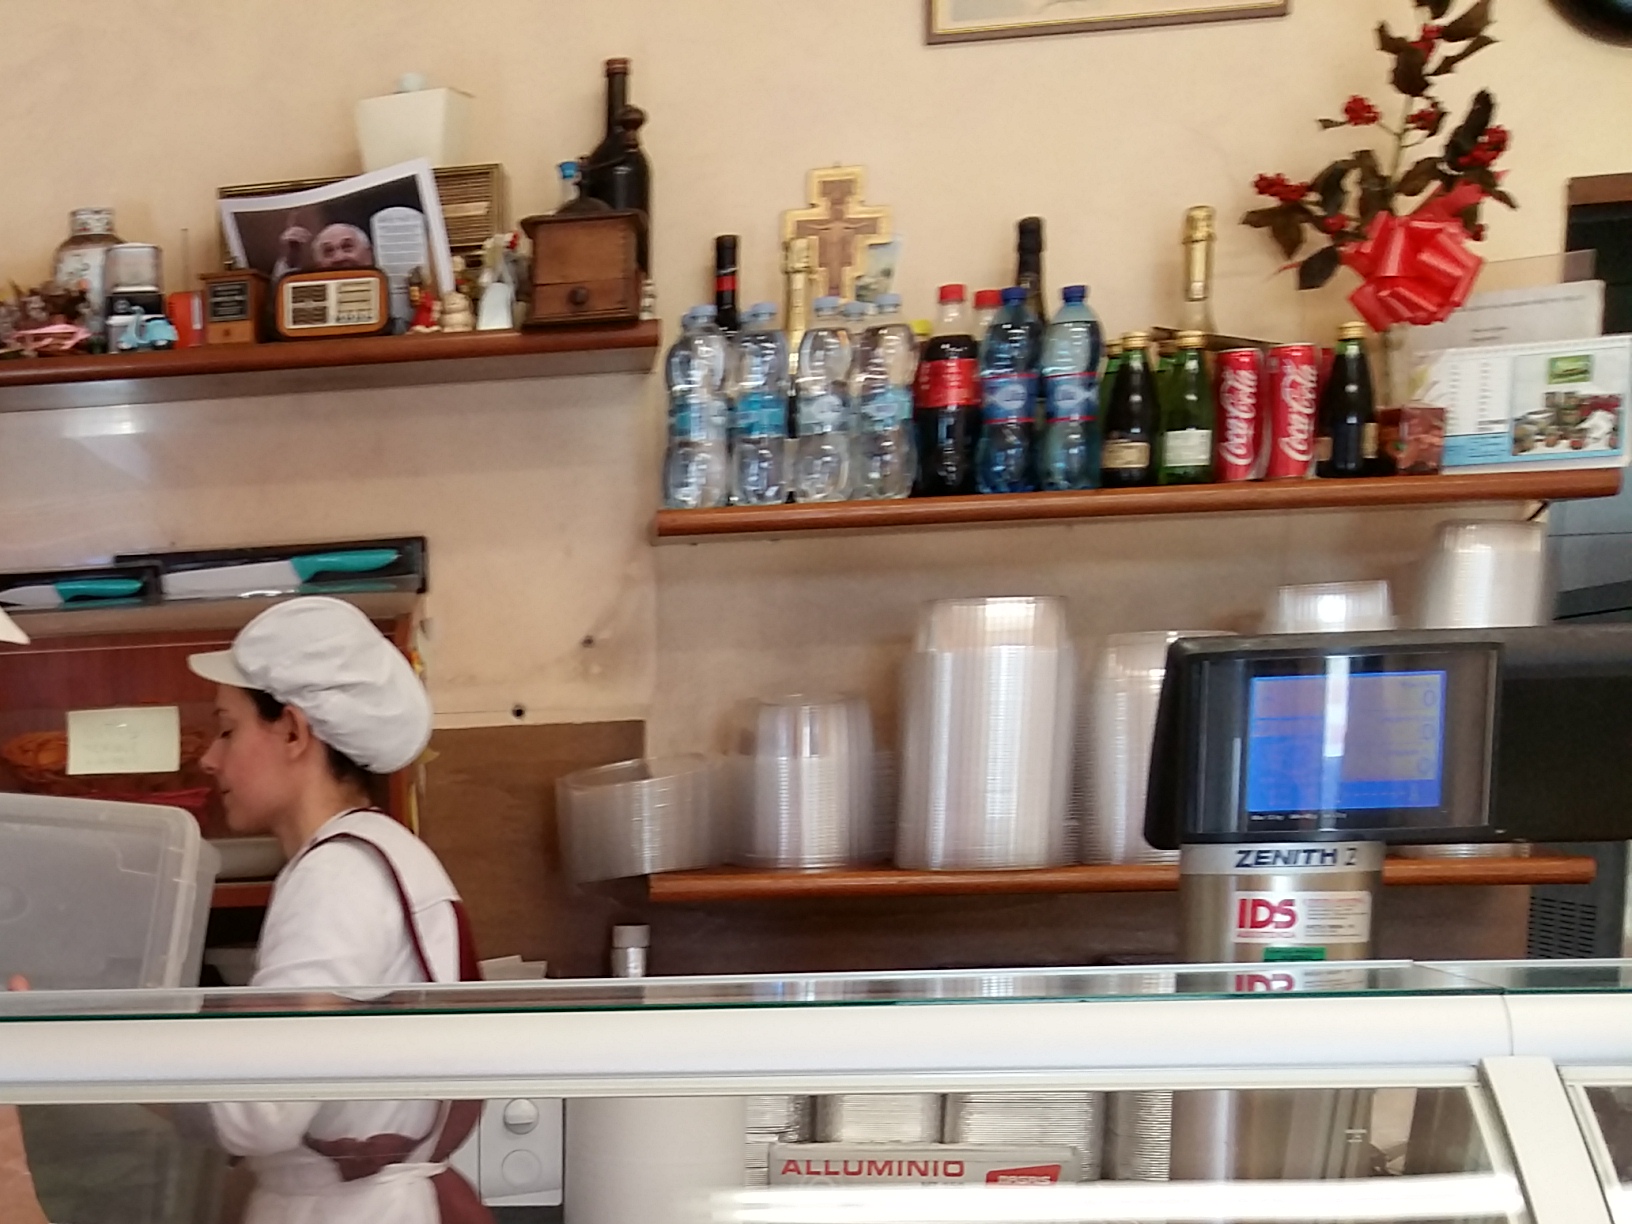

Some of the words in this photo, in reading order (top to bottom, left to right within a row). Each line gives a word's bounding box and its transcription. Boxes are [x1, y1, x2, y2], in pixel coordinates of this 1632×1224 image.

[1235, 847, 1338, 868] ZENITH
[1237, 898, 1298, 929] IDS
[781, 1159, 965, 1177] ALLUMINIO
